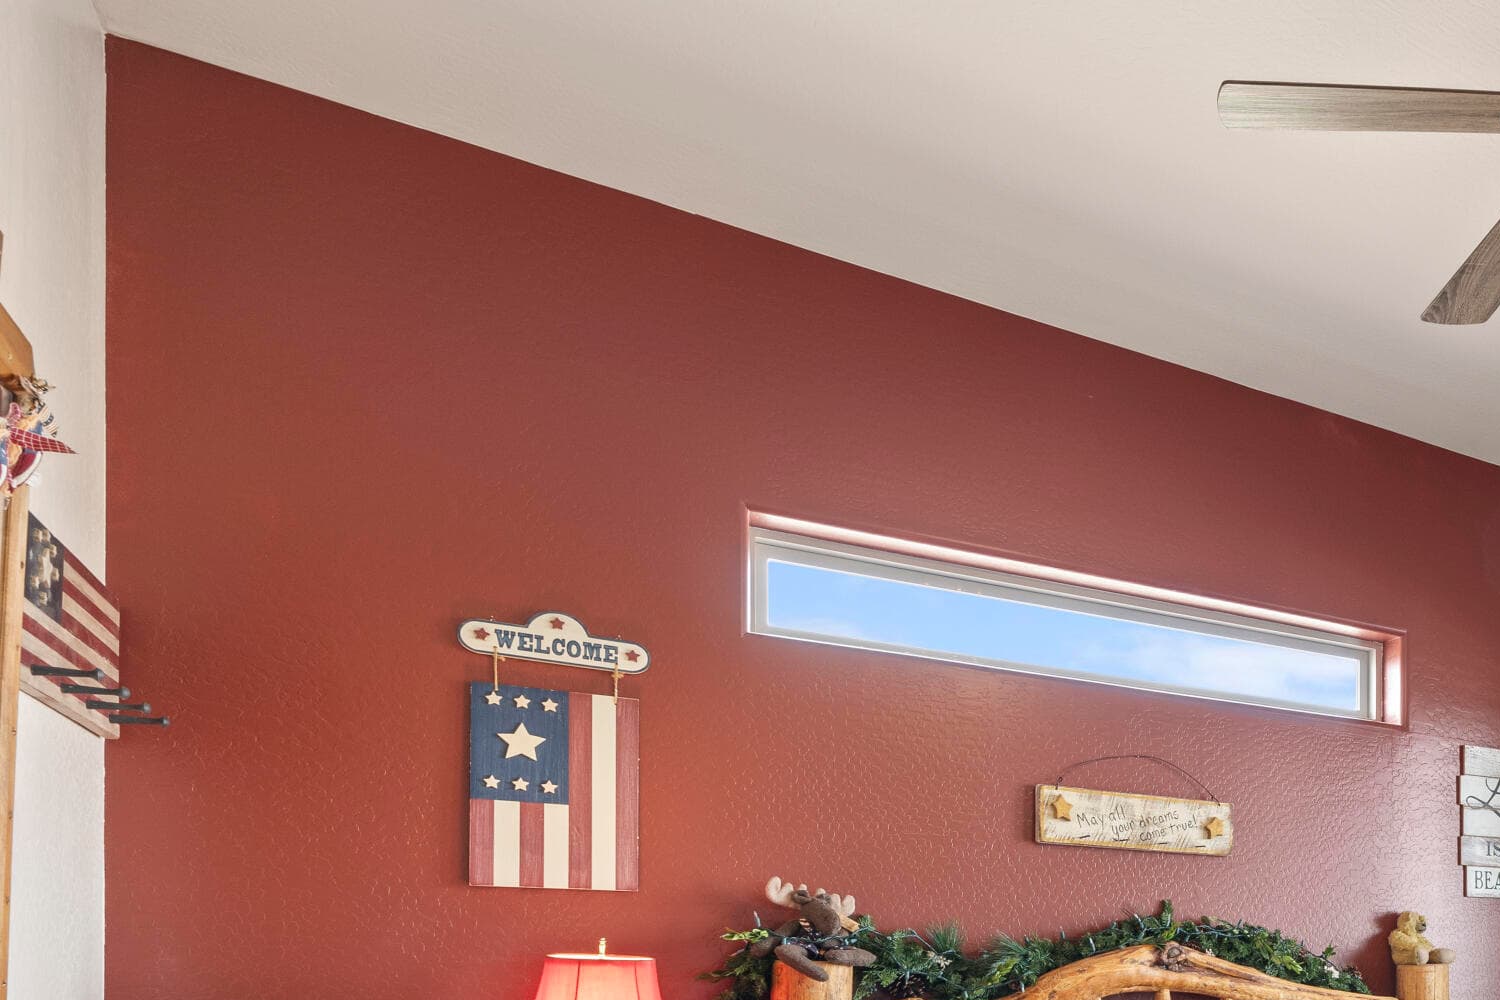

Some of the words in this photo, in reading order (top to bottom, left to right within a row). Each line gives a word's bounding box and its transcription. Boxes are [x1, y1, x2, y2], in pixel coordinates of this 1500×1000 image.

[494, 628, 619, 664] WELCOME
[1076, 812, 1105, 829] May
[1108, 805, 1126, 822] all
[1111, 819, 1135, 839] your
[1139, 809, 1180, 828] dreams
[1139, 826, 1167, 842] come
[1169, 813, 1198, 834] true!
